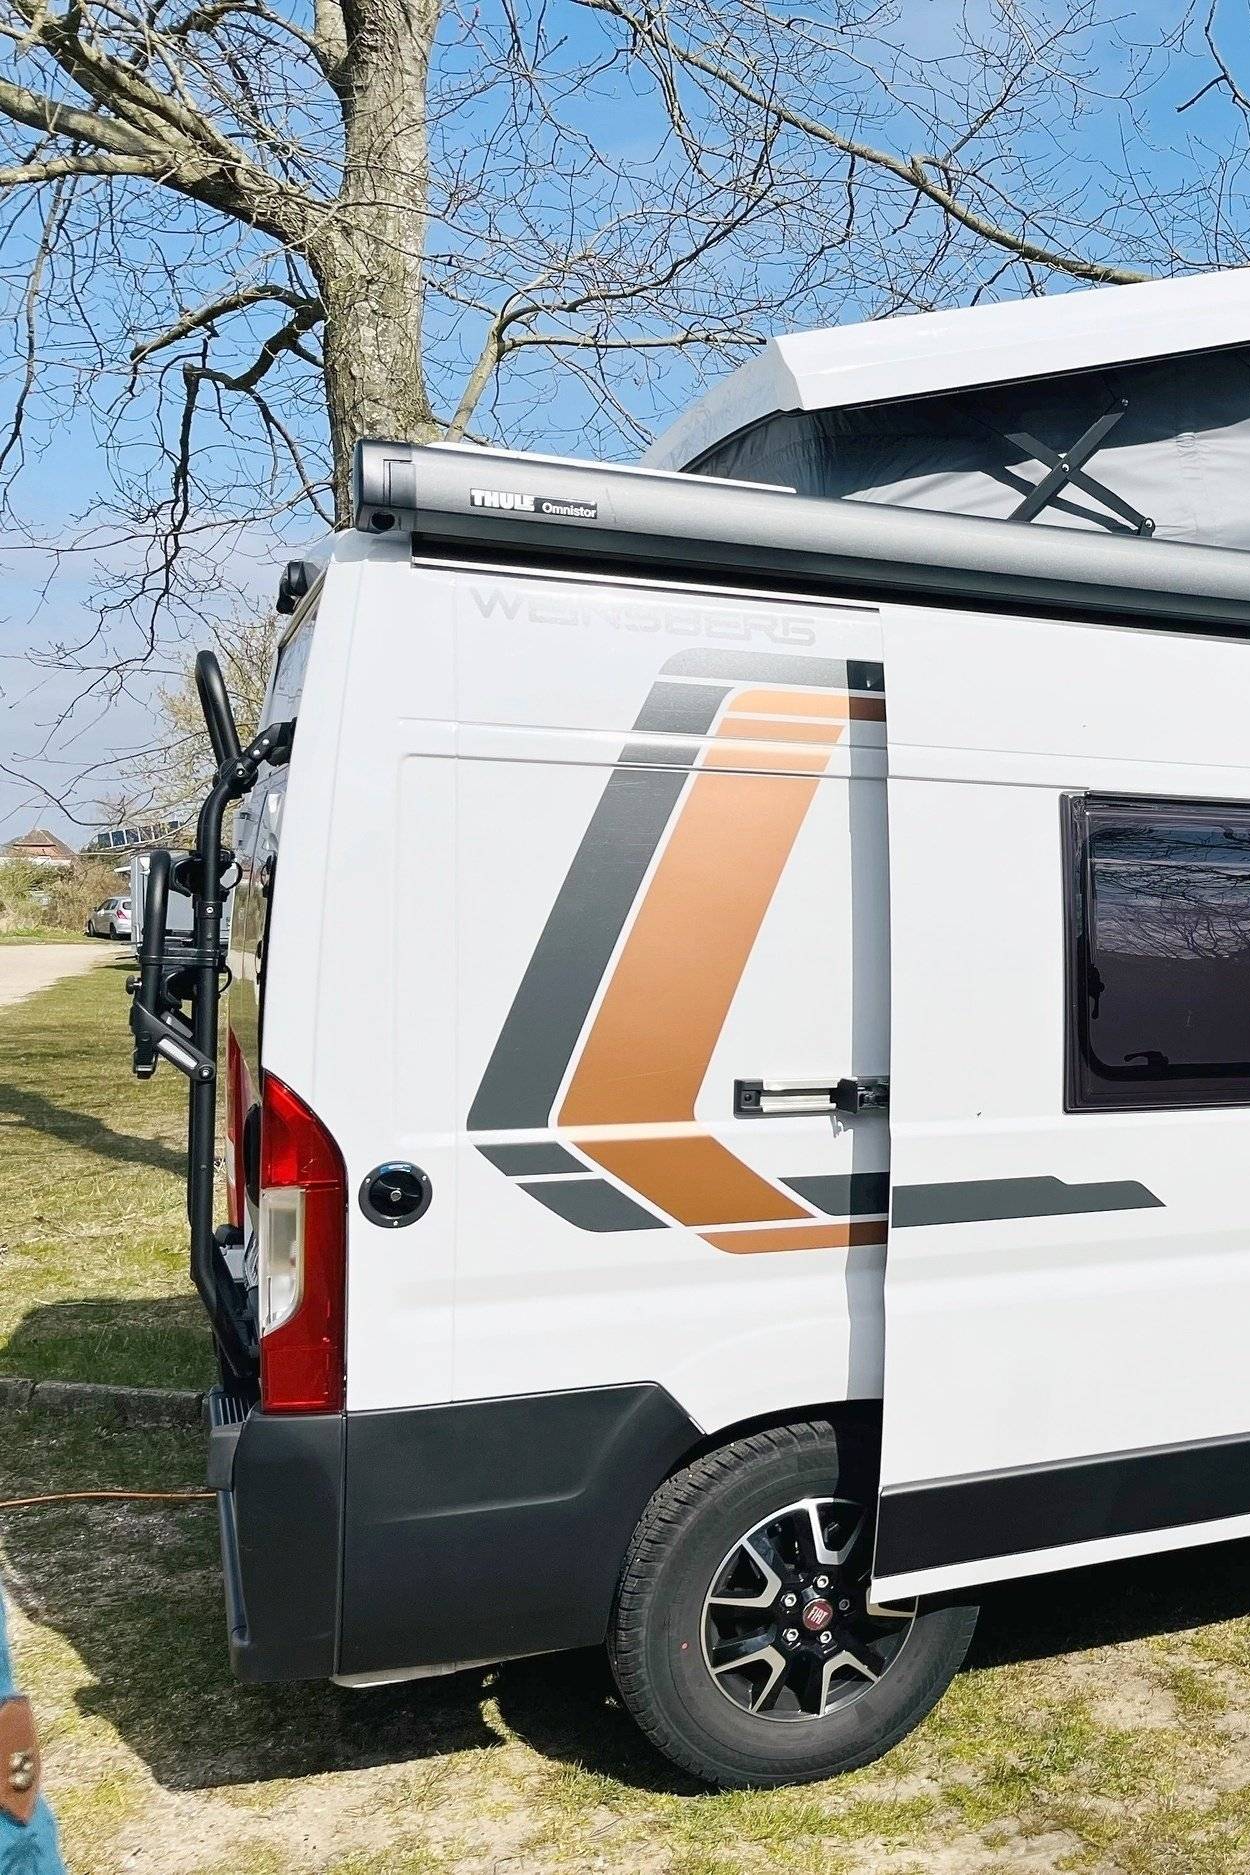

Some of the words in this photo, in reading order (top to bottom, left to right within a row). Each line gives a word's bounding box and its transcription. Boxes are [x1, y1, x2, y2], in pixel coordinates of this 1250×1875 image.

[470, 489, 535, 511] THULE
[542, 502, 597, 518] Omnistor
[807, 1605, 829, 1625] FIAT
